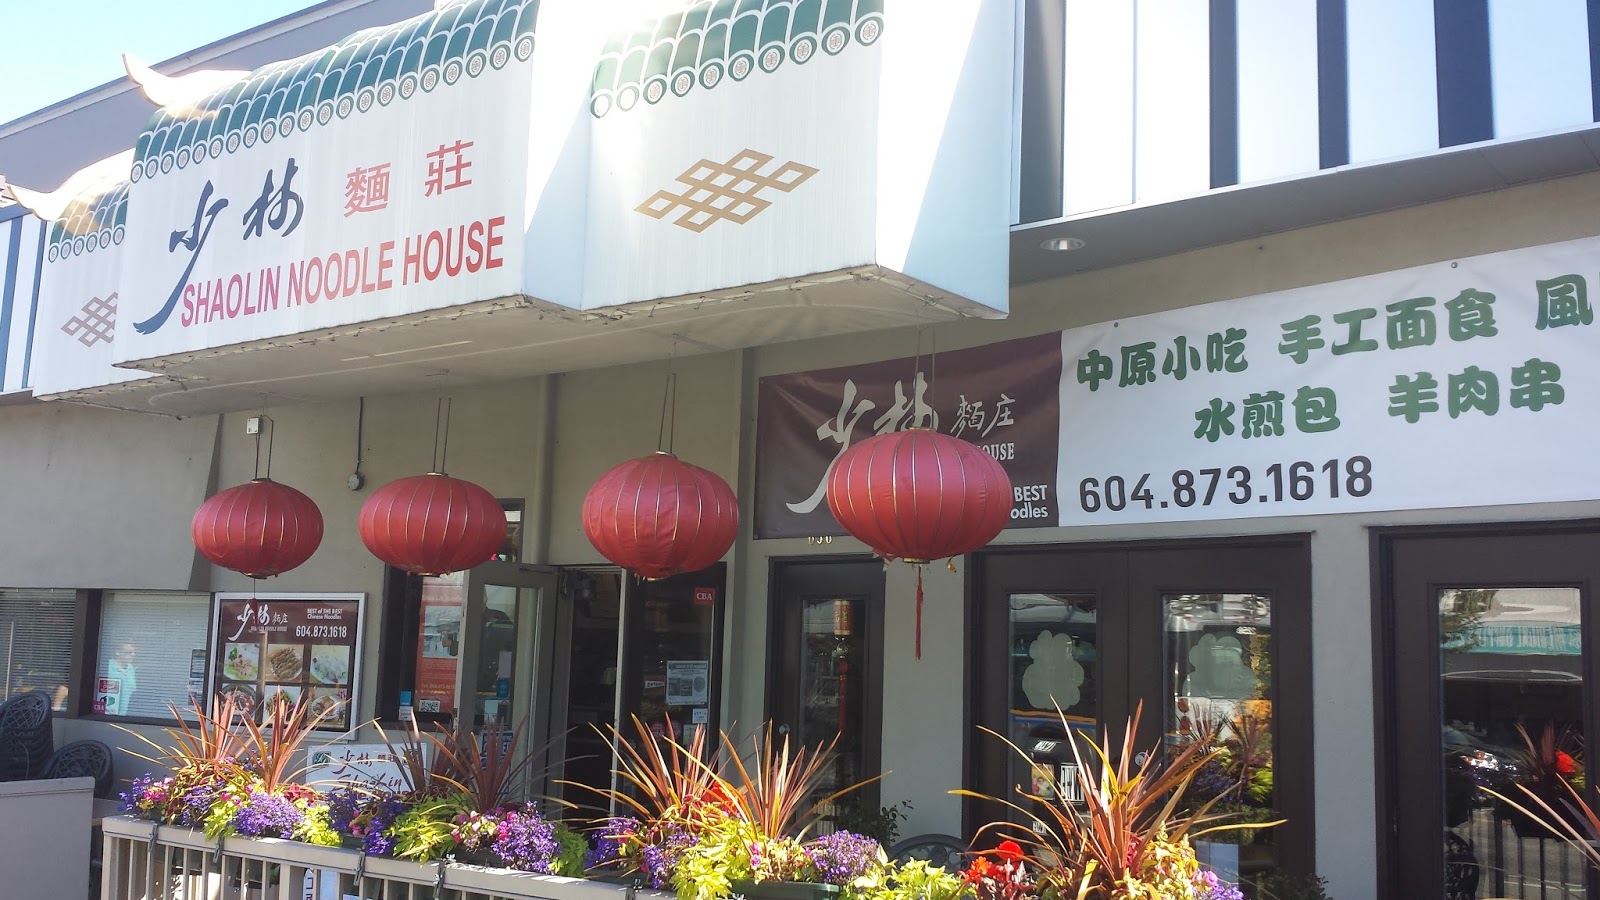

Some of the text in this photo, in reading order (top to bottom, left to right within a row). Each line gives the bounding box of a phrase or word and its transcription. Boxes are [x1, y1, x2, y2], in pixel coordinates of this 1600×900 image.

[344, 140, 474, 217] 麵莊
[181, 215, 506, 329] SHAOLIN NOODLE HOUSE
[1076, 273, 1600, 392] 中原小吃 手工面食 風
[1194, 357, 1565, 443] 水煎包 羊肉串
[977, 442, 1016, 461] OUSE
[1010, 501, 1049, 519] odles
[1013, 484, 1048, 502] BEST
[1079, 455, 1373, 514] 604.873.1618
[295, 625, 347, 638] 604.873.1618
